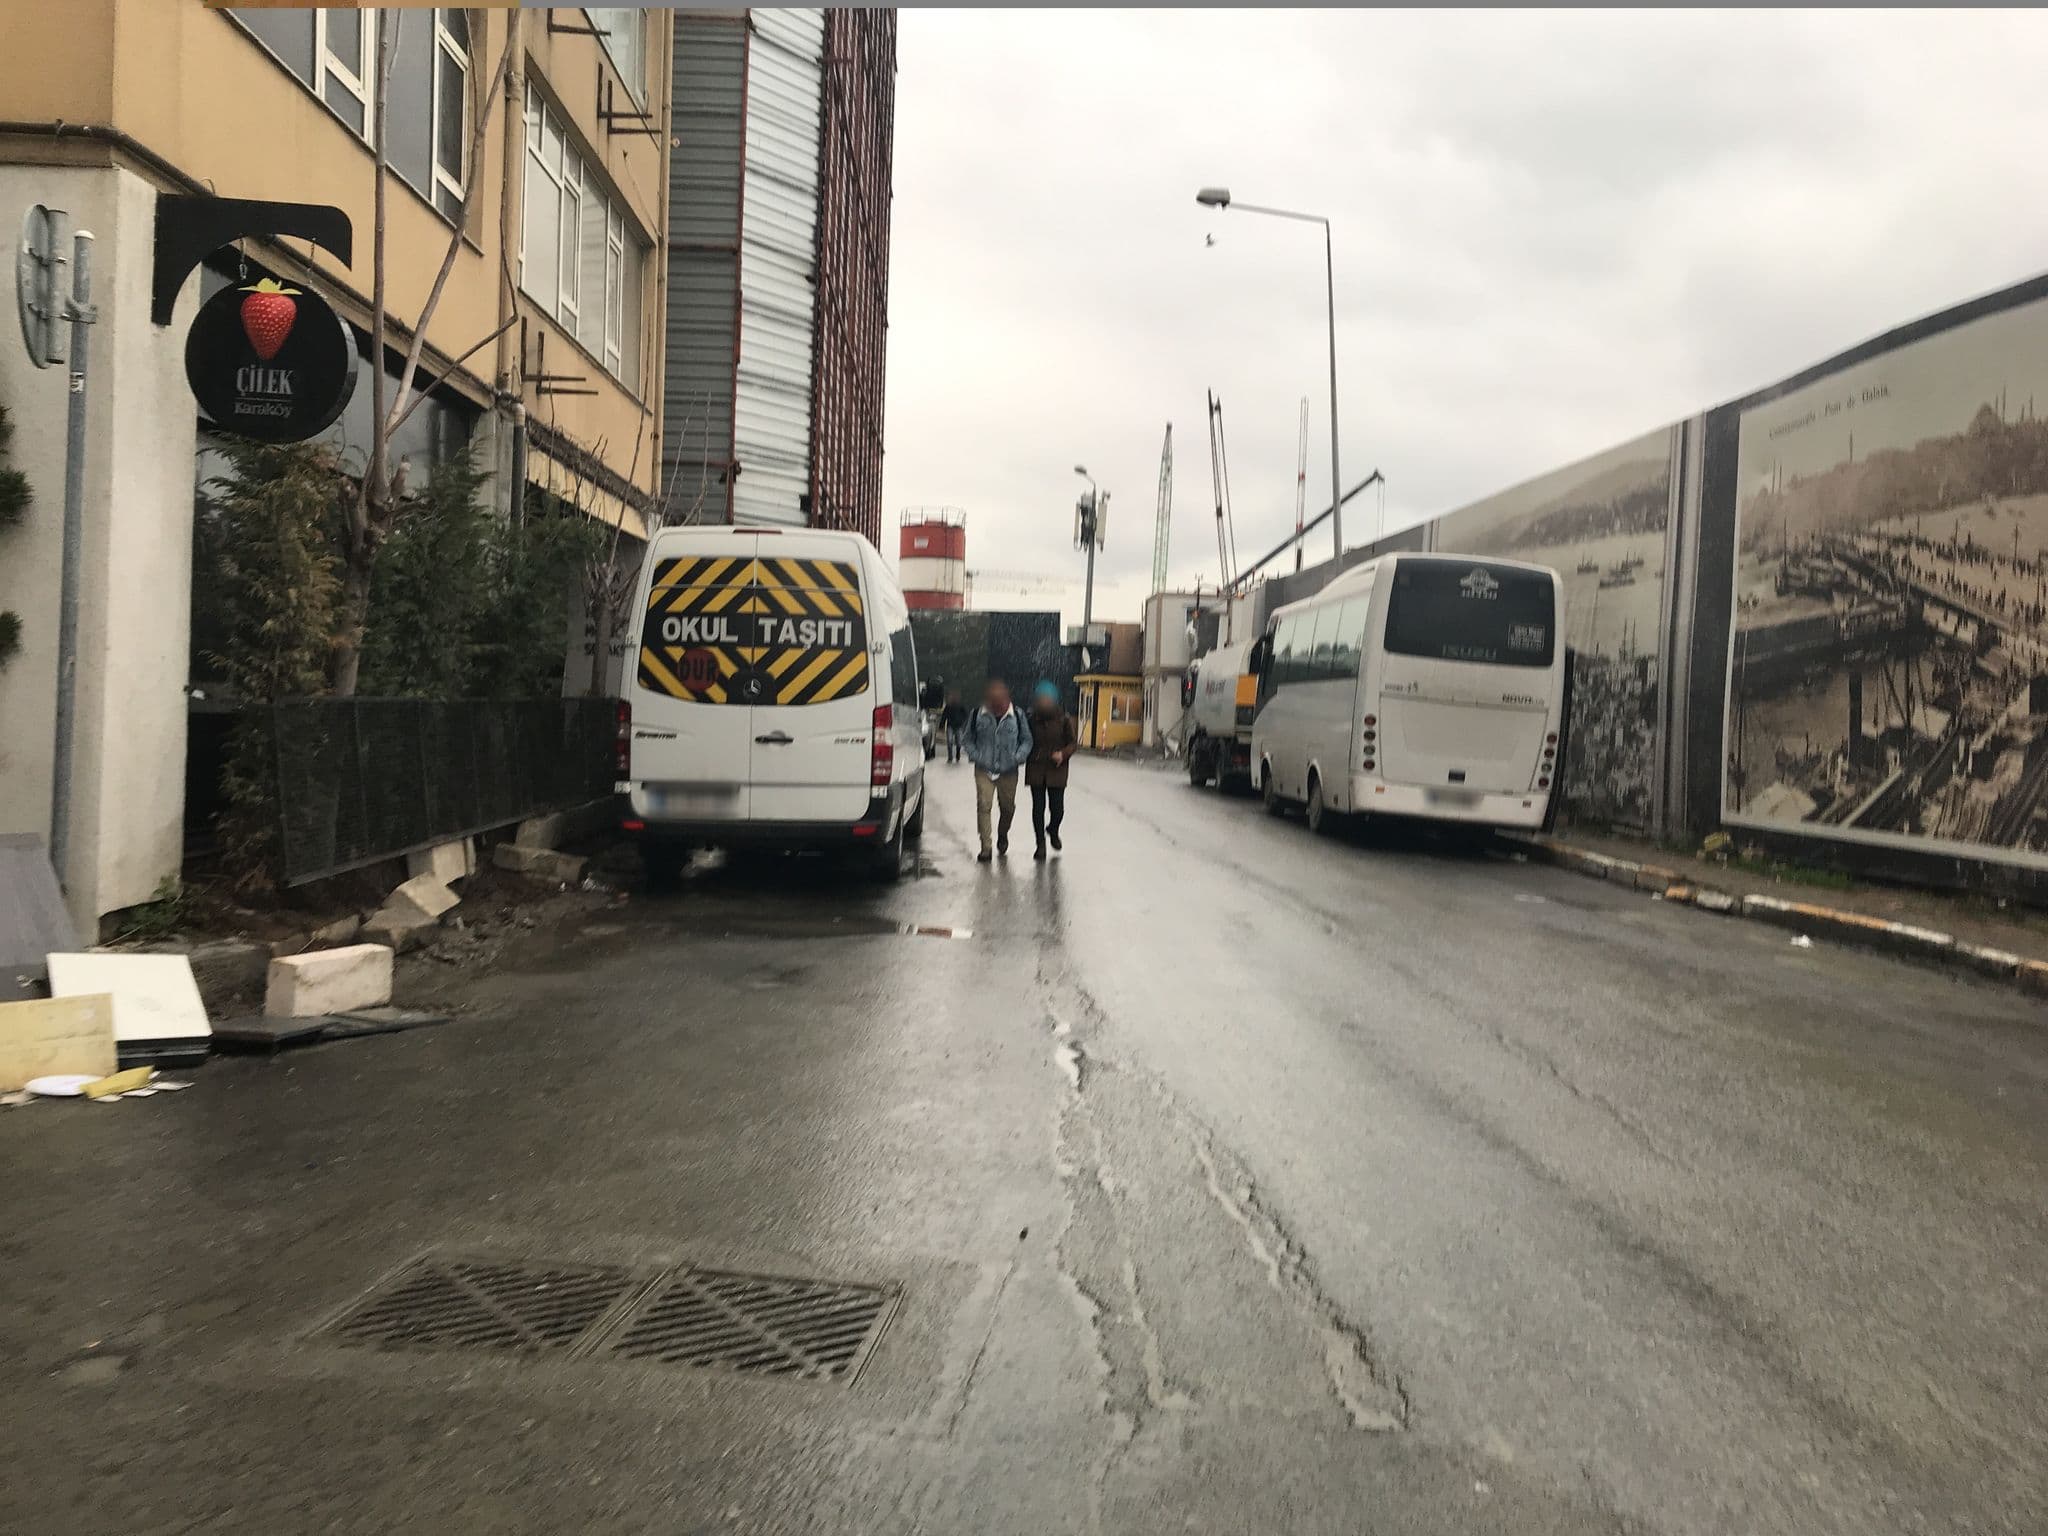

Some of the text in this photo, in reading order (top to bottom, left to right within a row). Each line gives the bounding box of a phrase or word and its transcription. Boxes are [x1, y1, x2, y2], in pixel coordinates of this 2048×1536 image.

[237, 364, 293, 396] ÇİLEK
[235, 402, 292, 418] Karaköy
[662, 616, 738, 643] OKUL
[758, 616, 852, 650] TAŞITI
[679, 657, 717, 682] DUR
